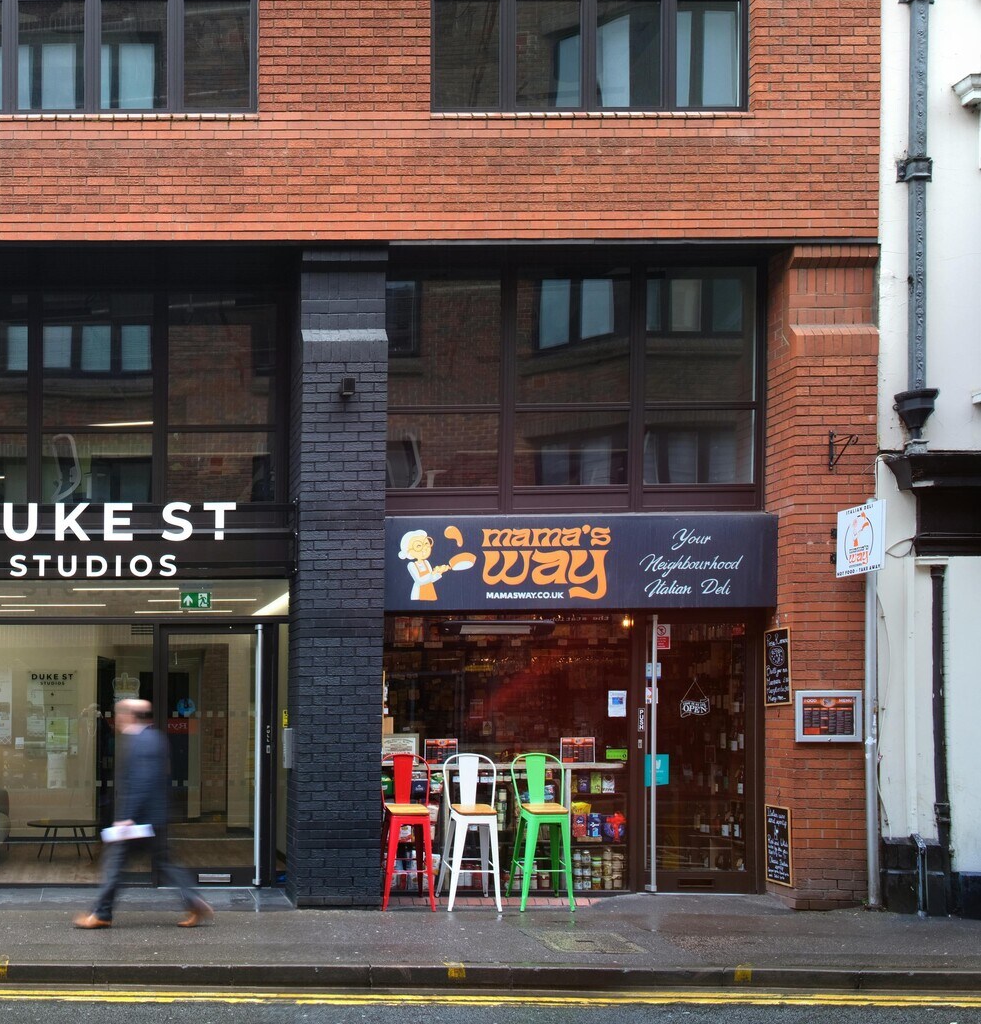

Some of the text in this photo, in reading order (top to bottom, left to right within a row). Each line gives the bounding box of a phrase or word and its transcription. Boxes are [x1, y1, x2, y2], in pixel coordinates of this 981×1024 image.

[161, 501, 237, 542] ST
[846, 507, 862, 515] ITALIAN
[481, 524, 611, 547] mama's
[671, 528, 711, 551] Your
[9, 554, 177, 577] STUDIOS
[483, 548, 609, 600] way
[639, 553, 744, 578] Neighbourhood
[486, 591, 564, 599] MAMASWAY.CO.UK
[644, 578, 731, 598] Italian Deli
[682, 704, 708, 714] OPEN
